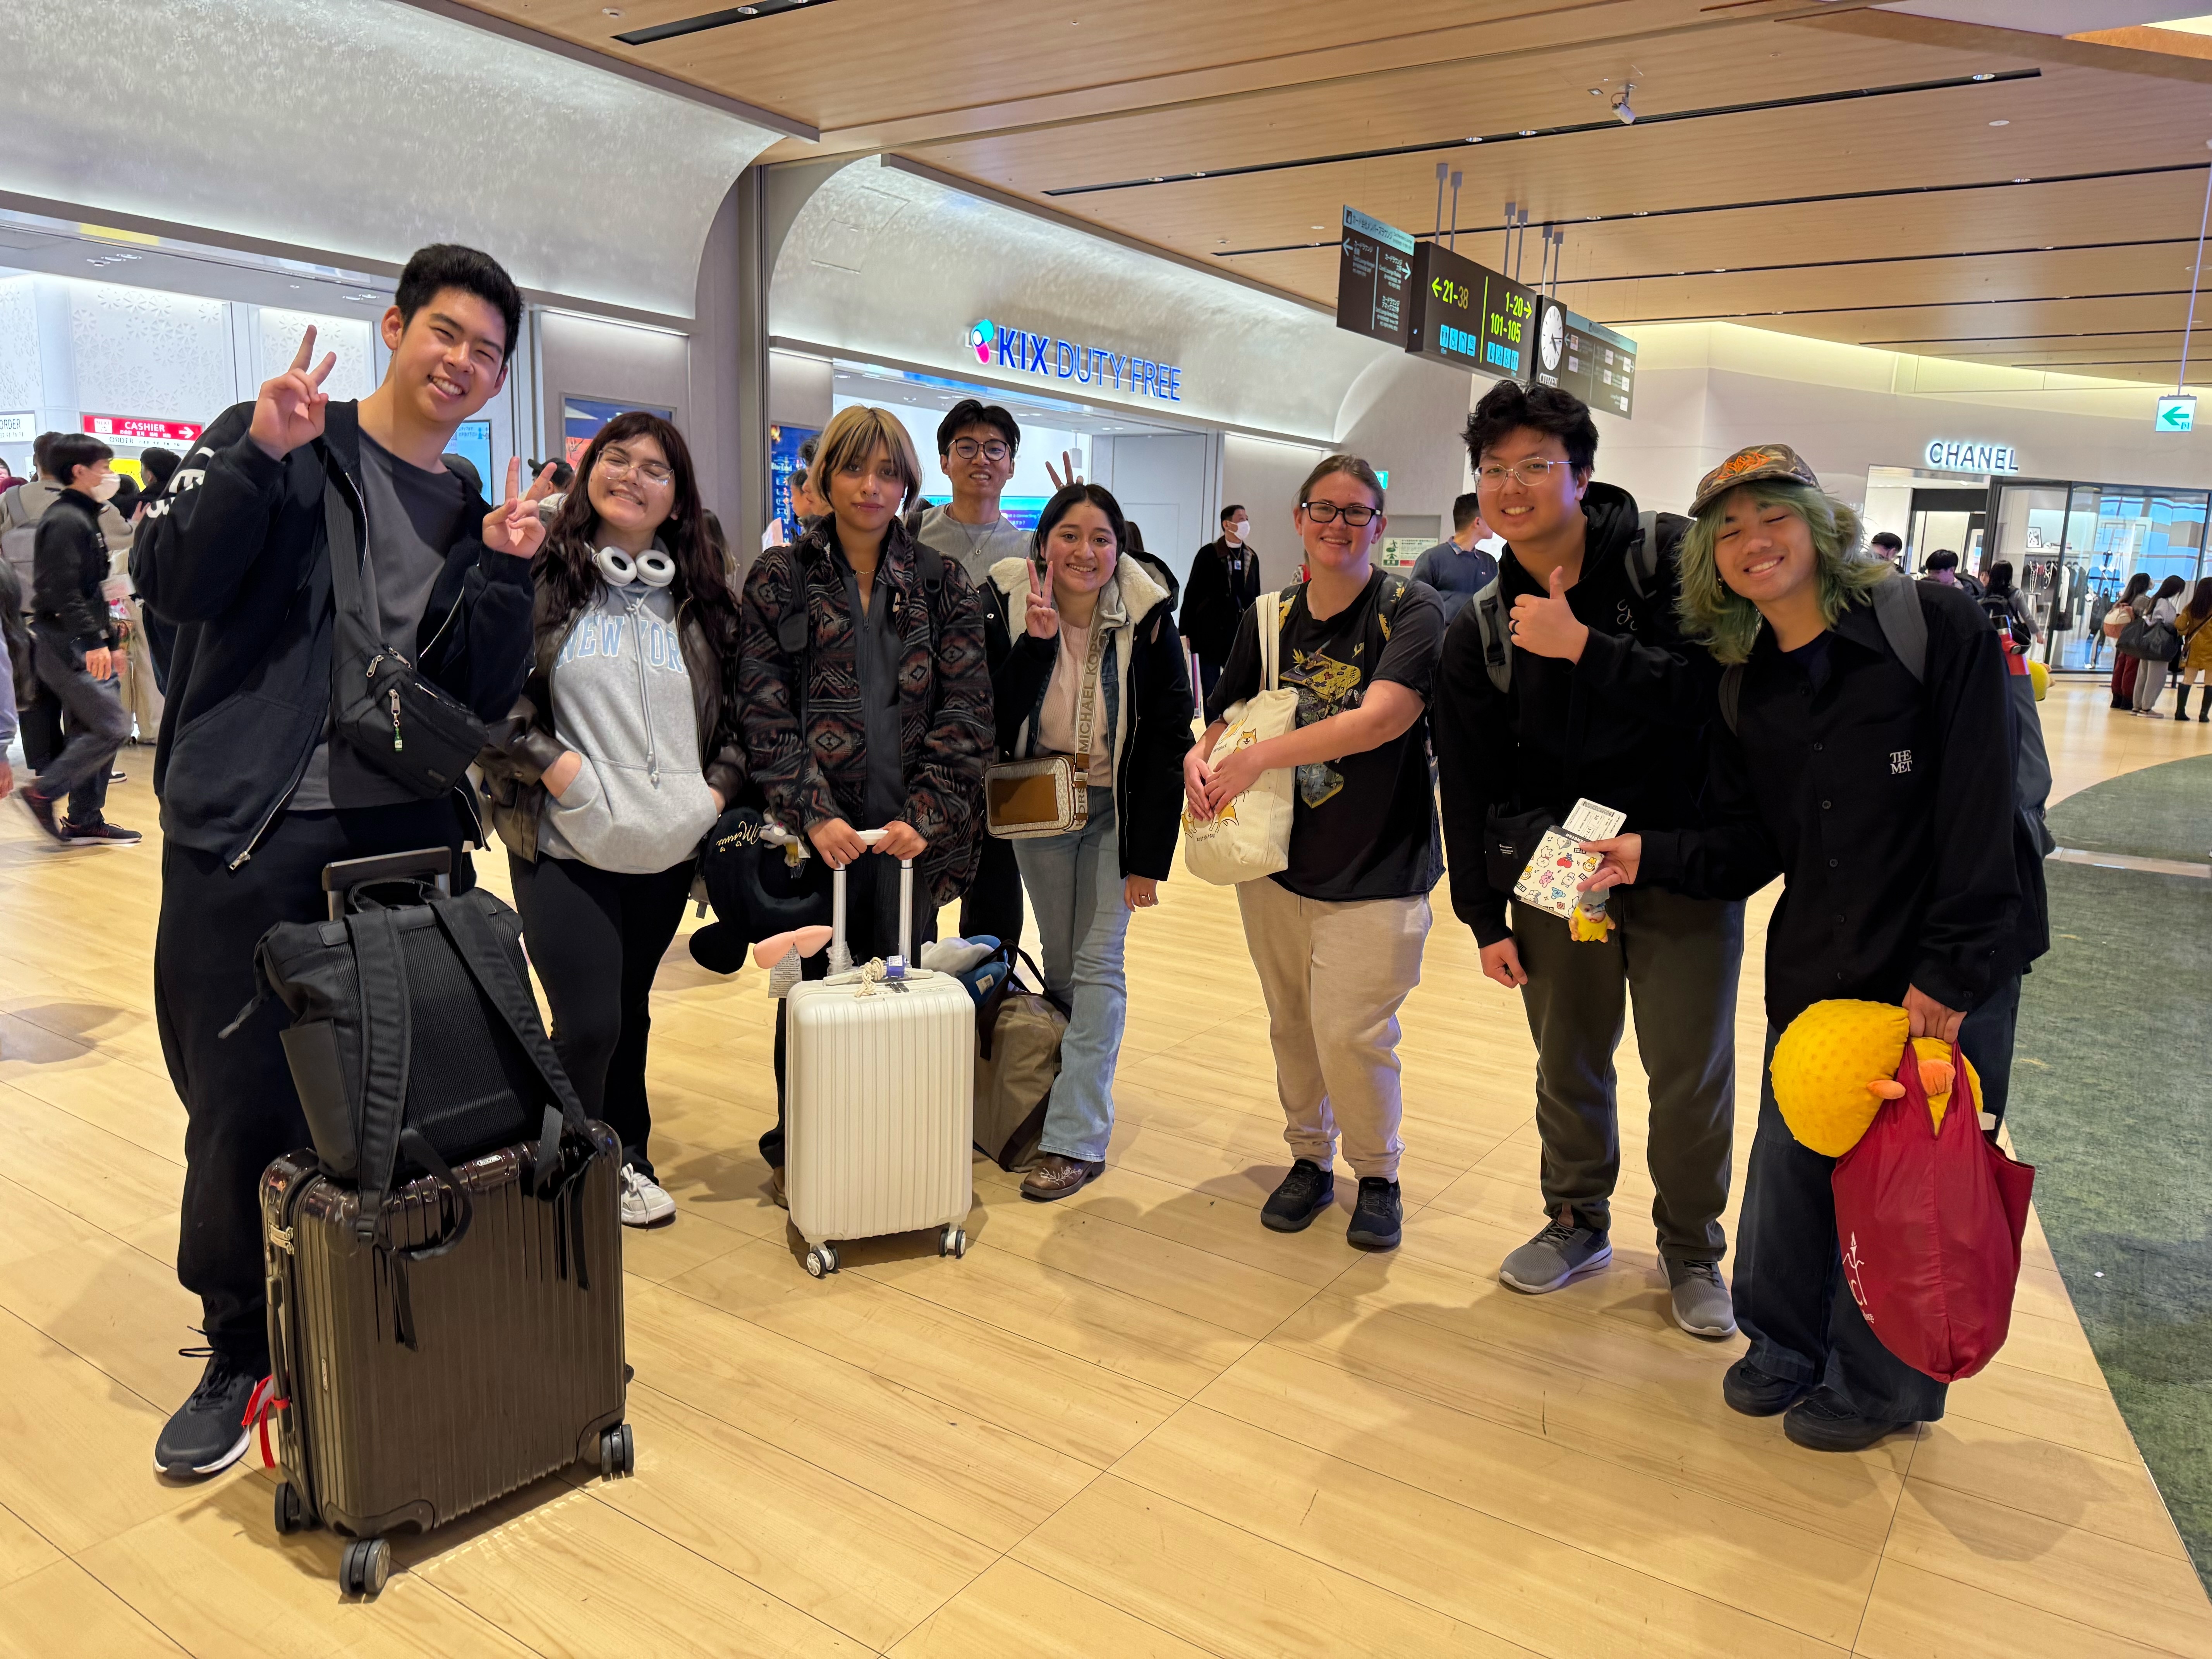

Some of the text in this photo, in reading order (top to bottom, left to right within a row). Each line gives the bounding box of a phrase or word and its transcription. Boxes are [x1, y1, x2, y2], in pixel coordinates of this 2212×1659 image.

[1443, 279, 1469, 309] 21-38
[1506, 292, 1523, 318] 1-20
[1491, 313, 1521, 343] 101-105
[998, 325, 1182, 402] KIX DUTY FREE
[125, 421, 165, 432] CASHIER
[1928, 441, 2019, 472] CHANEL
[556, 614, 624, 669] NEW
[1079, 682, 1095, 753] MICHAEL
[1890, 750, 1912, 763] THE
[1890, 760, 1913, 774] MET
[716, 821, 762, 852] Minnie
